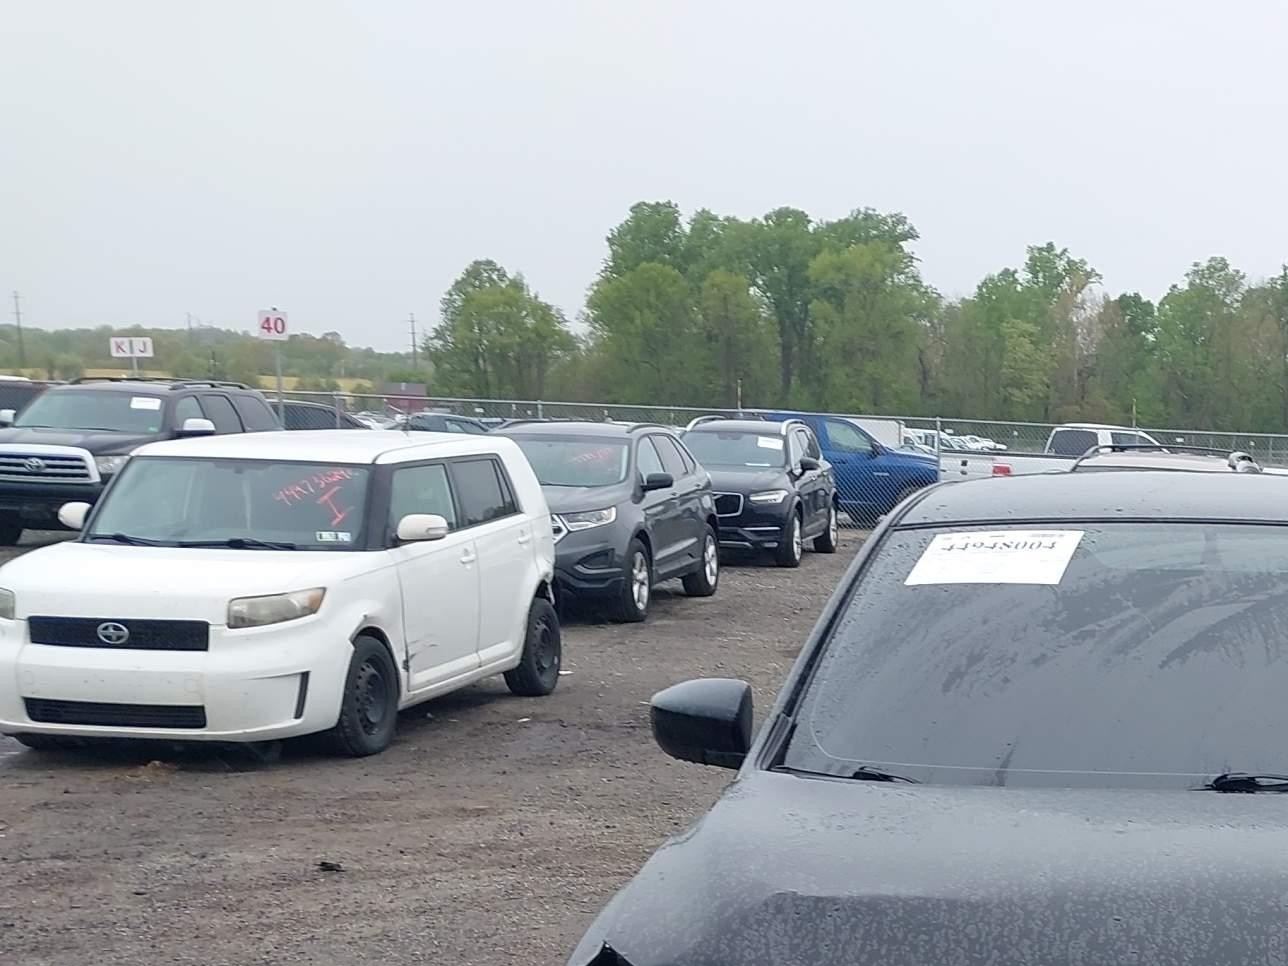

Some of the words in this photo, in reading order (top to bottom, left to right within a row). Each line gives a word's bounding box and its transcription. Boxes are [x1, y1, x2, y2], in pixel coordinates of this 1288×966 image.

[261, 316, 286, 334] 40
[115, 341, 126, 353] K
[138, 341, 148, 353] J
[940, 540, 1057, 552] 44948004
